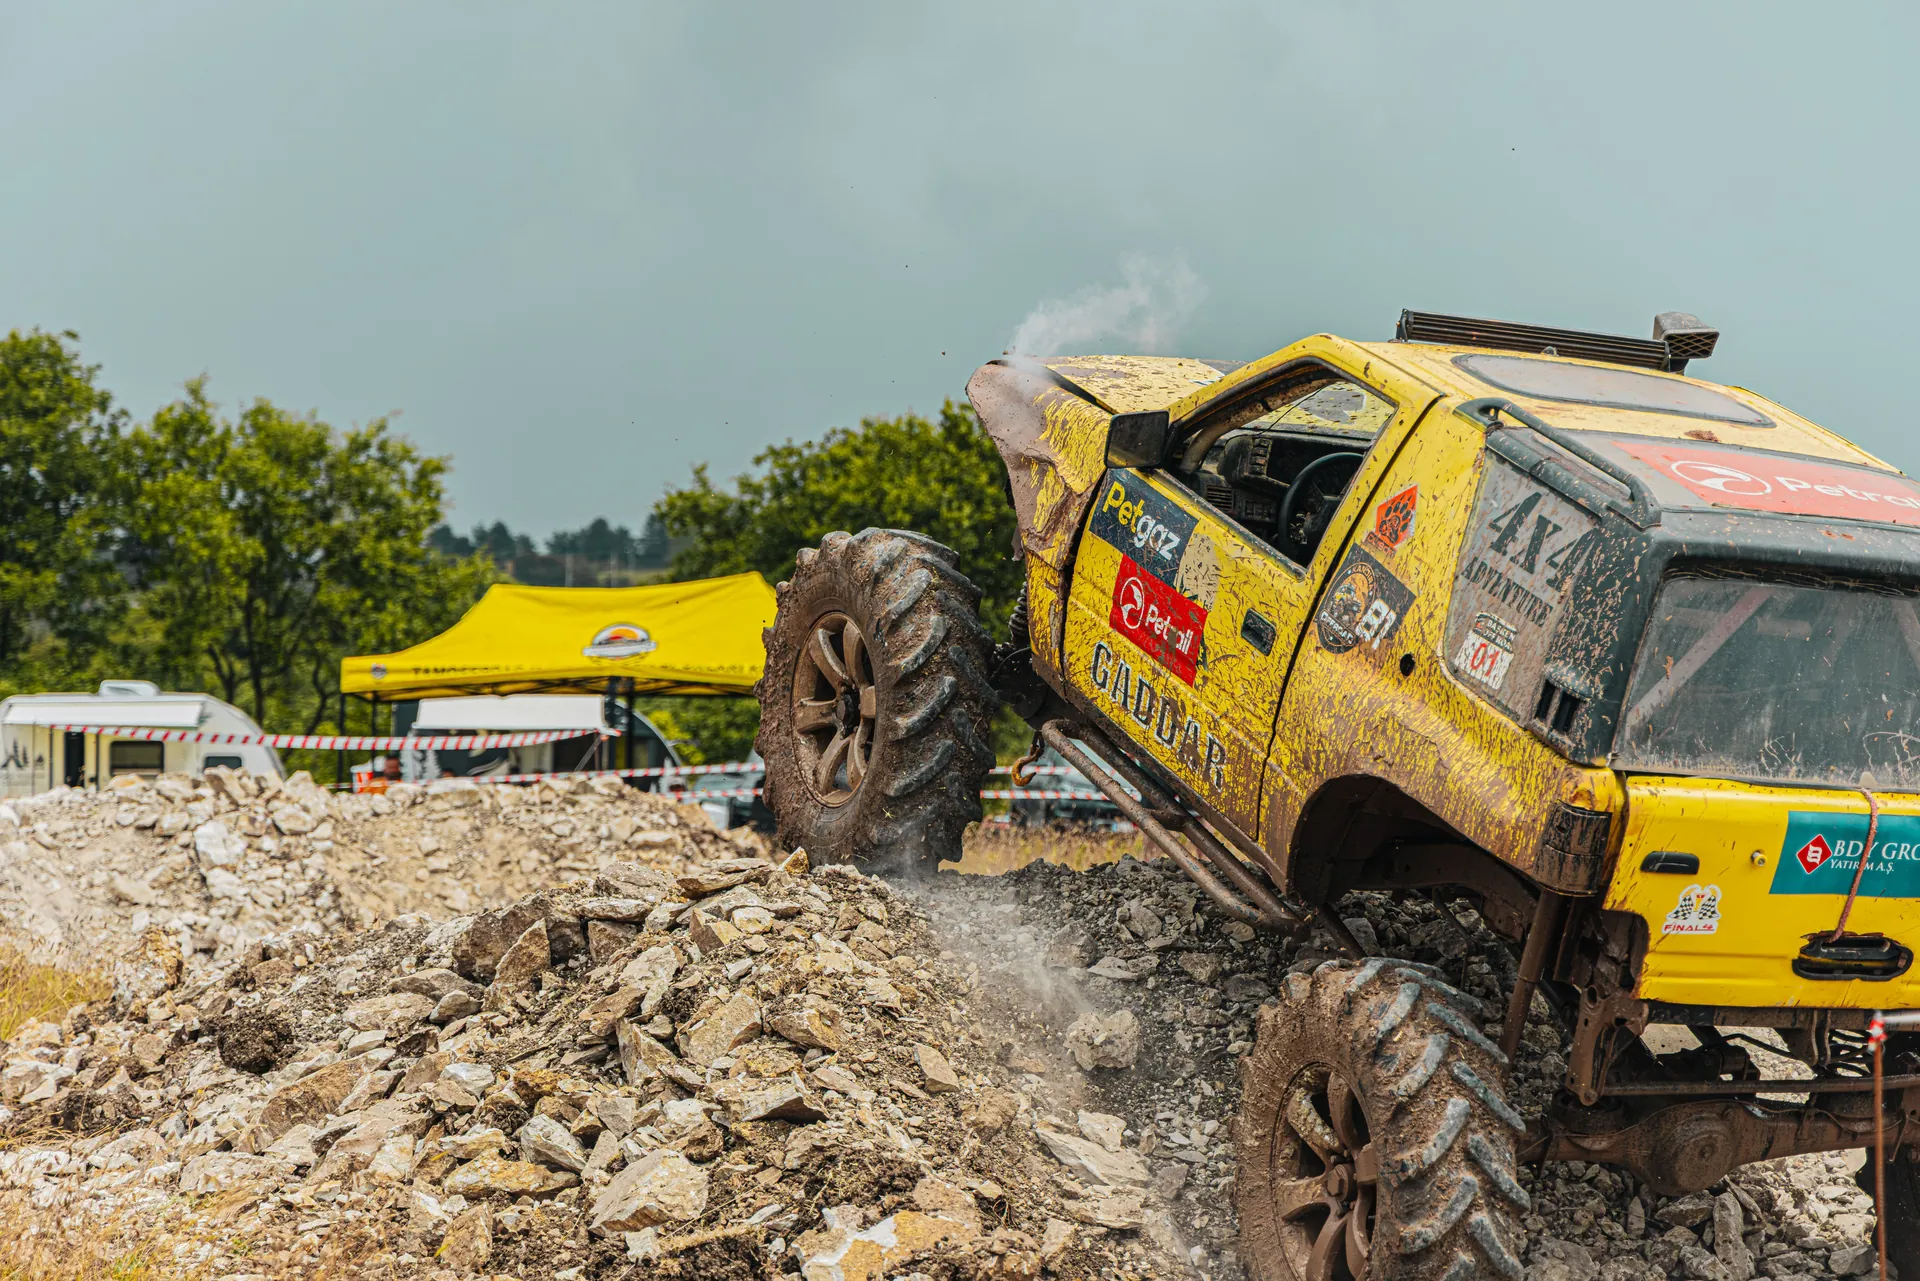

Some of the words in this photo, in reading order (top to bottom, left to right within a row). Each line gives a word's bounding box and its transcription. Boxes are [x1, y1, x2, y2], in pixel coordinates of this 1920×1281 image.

[1102, 480, 1181, 561] Petgaz
[1461, 556, 1554, 628] ADVENTURE
[1470, 642, 1501, 677] 01
[1090, 641, 1227, 793] GADDAR
[1830, 858, 1875, 871] YATIRM
[1833, 839, 1879, 858] BDY
